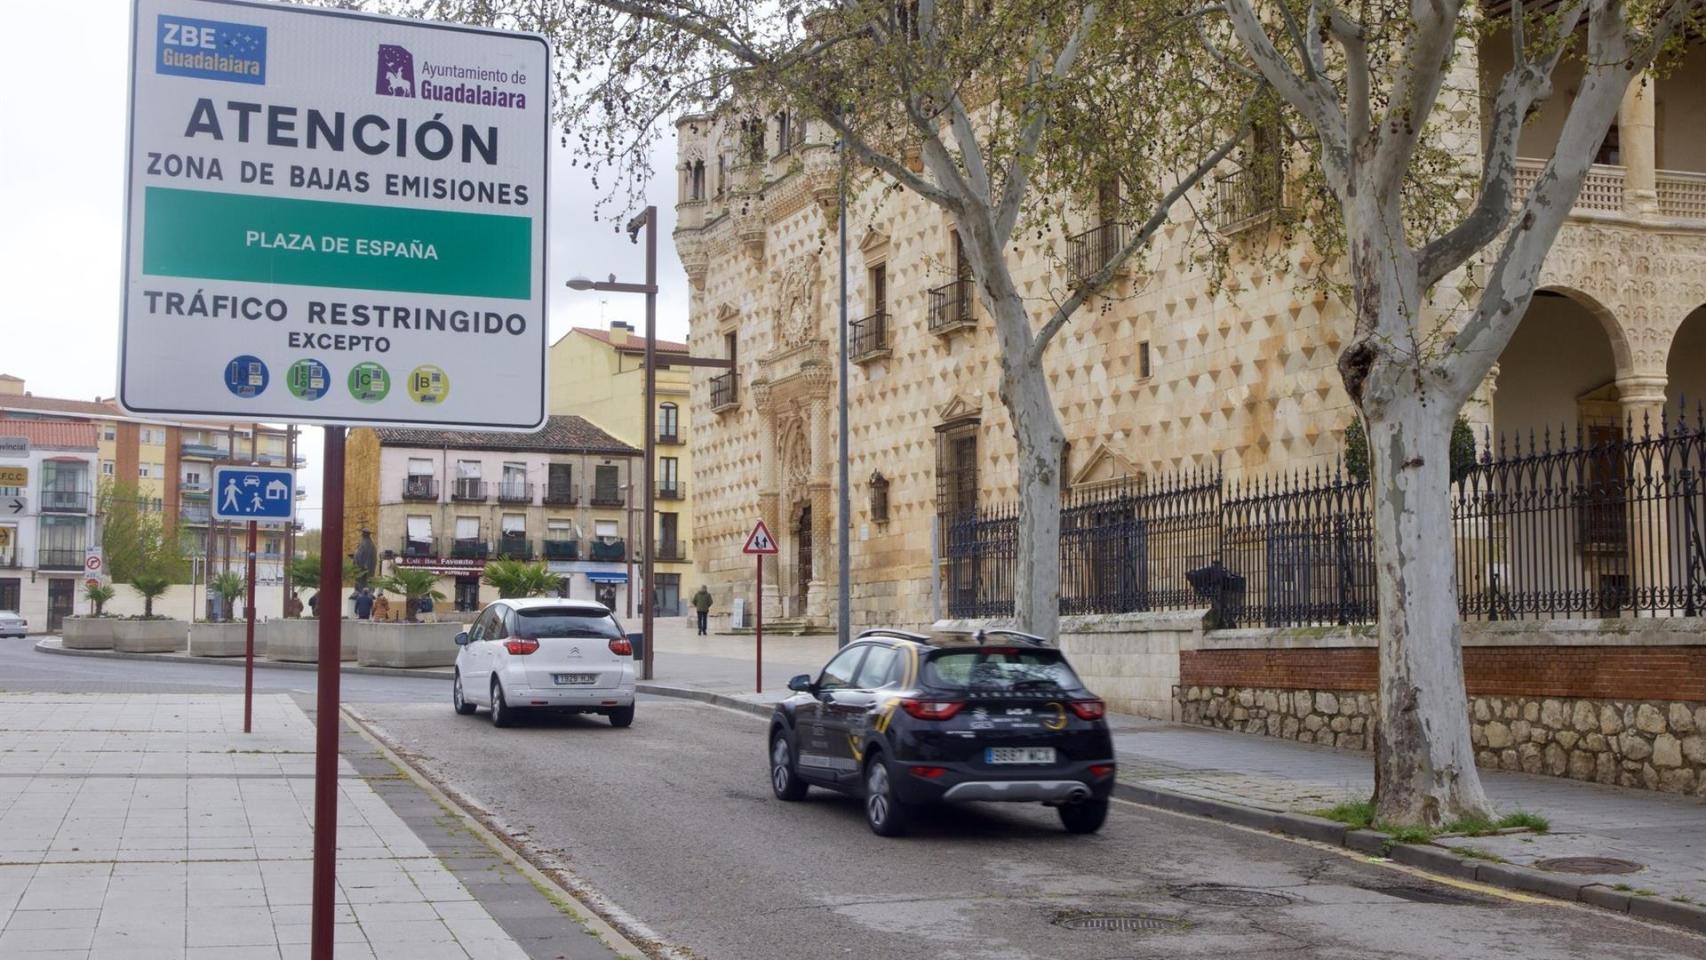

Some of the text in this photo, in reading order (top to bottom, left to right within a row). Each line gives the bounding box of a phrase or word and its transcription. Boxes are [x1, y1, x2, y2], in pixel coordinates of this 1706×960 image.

[163, 23, 216, 49] ZBE
[163, 48, 260, 76] Guadalajara
[422, 61, 526, 84] Ayuntamiento de
[421, 80, 526, 109] Guadalajara
[184, 98, 498, 165] ATENCIÓN
[147, 152, 529, 206] ZONA DE BAJAS EMISIONES
[246, 230, 438, 260] PLAZA DE ESPAÑA
[143, 289, 527, 336] TRÁFICO RESTRINGIDO
[288, 332, 391, 353] EXCEPTO
[360, 374, 371, 386] C
[420, 377, 430, 388] B
